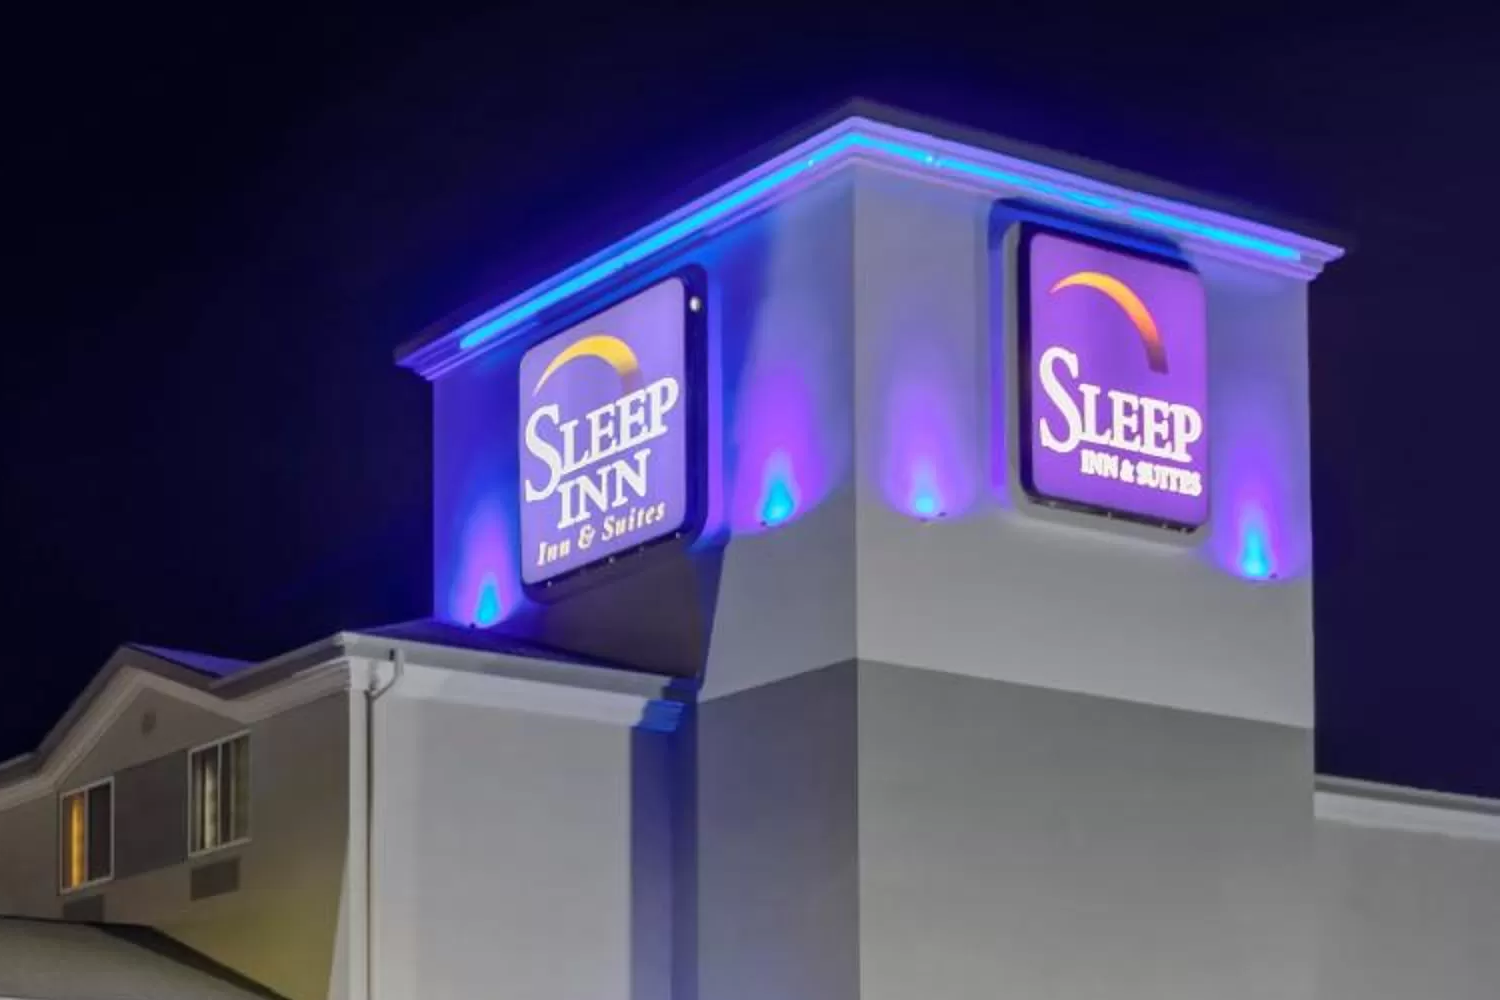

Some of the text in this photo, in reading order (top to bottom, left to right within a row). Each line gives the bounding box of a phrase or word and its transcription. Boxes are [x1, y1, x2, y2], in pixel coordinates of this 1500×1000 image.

[525, 377, 679, 503] SLEEP
[1039, 346, 1203, 463] SLEEP
[557, 448, 651, 529] INN
[1080, 449, 1203, 496] INN & SUITES
[537, 502, 665, 566] Inn & Suites
